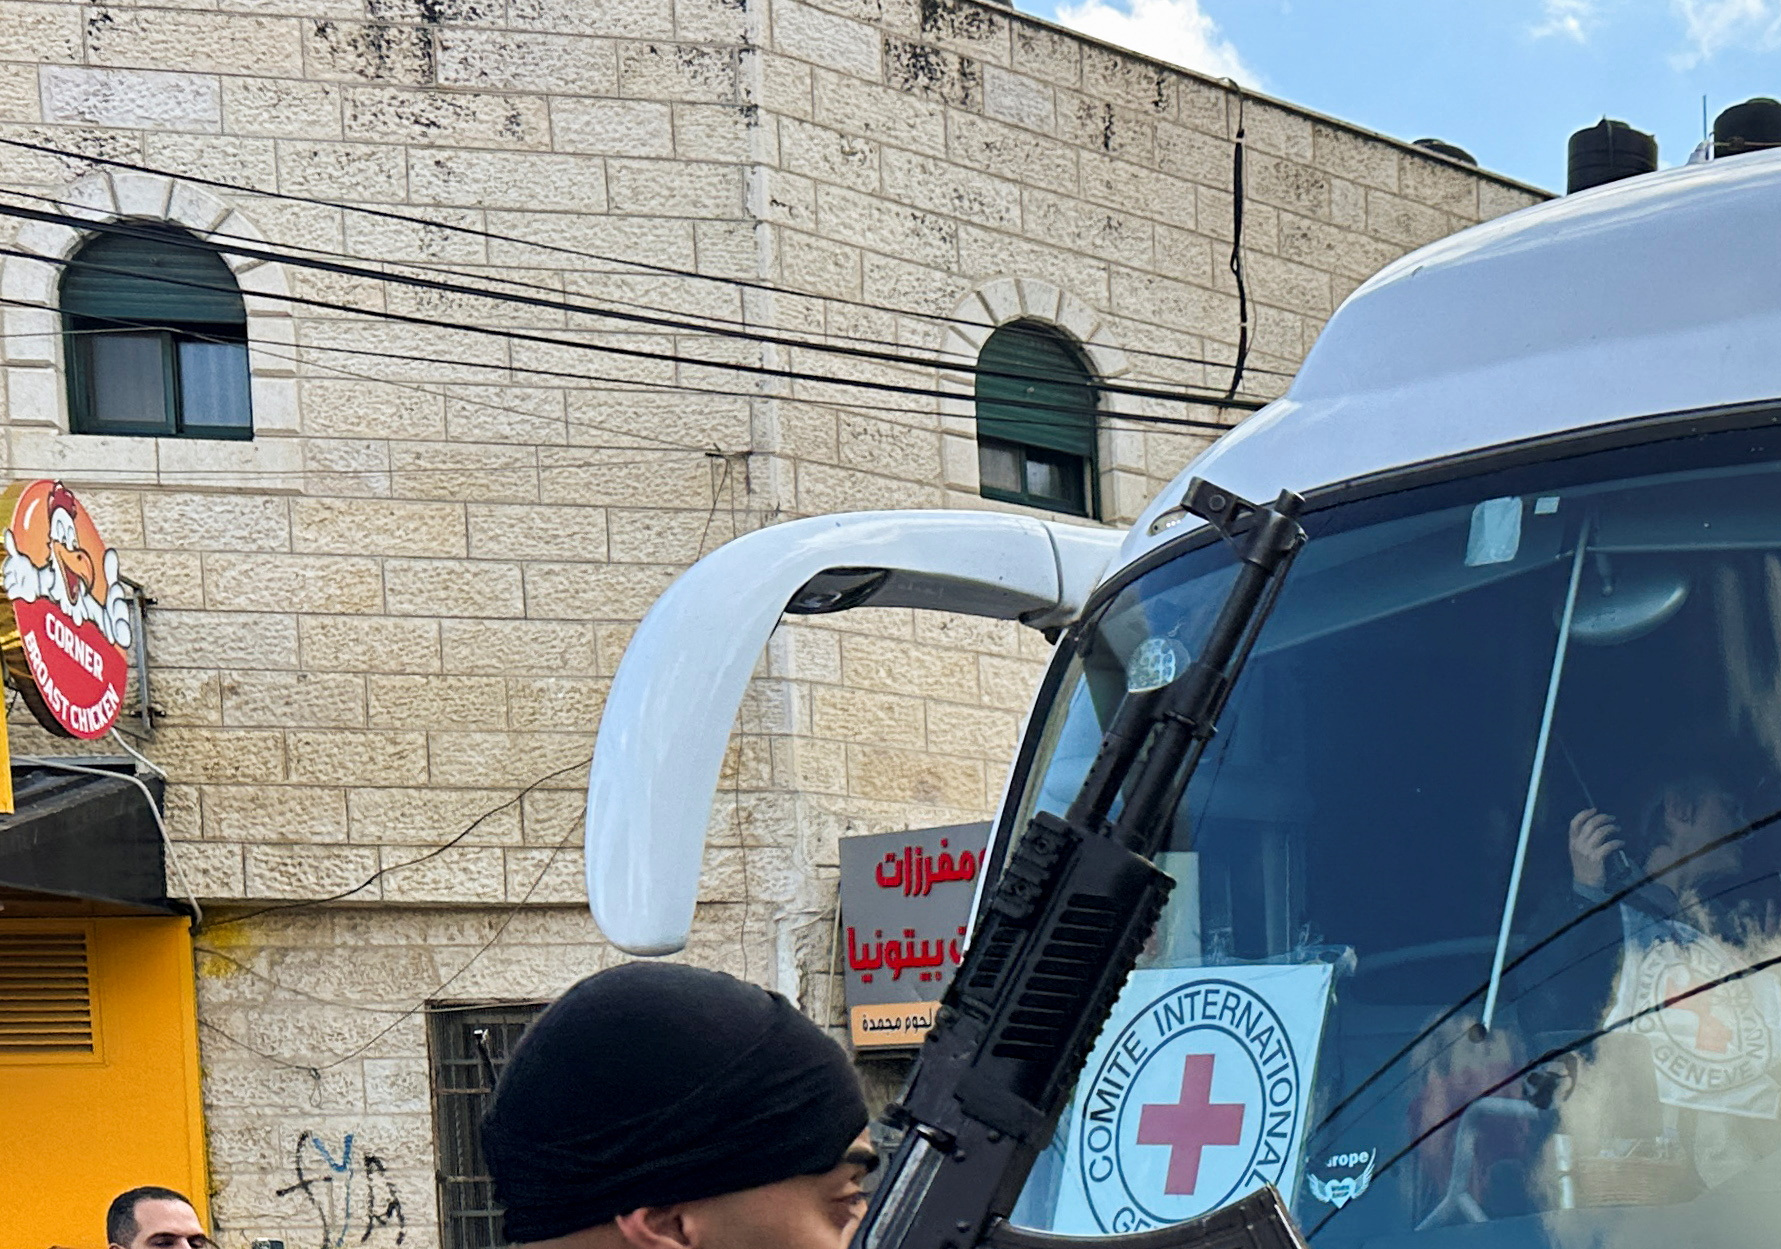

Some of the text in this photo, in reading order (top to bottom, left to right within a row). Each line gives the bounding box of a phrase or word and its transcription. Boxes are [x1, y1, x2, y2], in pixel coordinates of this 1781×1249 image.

[45, 612, 104, 682] CORNER
[24, 630, 120, 733] BROAST CHICKEN
[875, 837, 975, 897] مفرزات
[846, 926, 944, 984] بيتونيا
[904, 1007, 932, 1034] لحوم
[1087, 989, 1293, 1187] COMITE INTERNATIONAL
